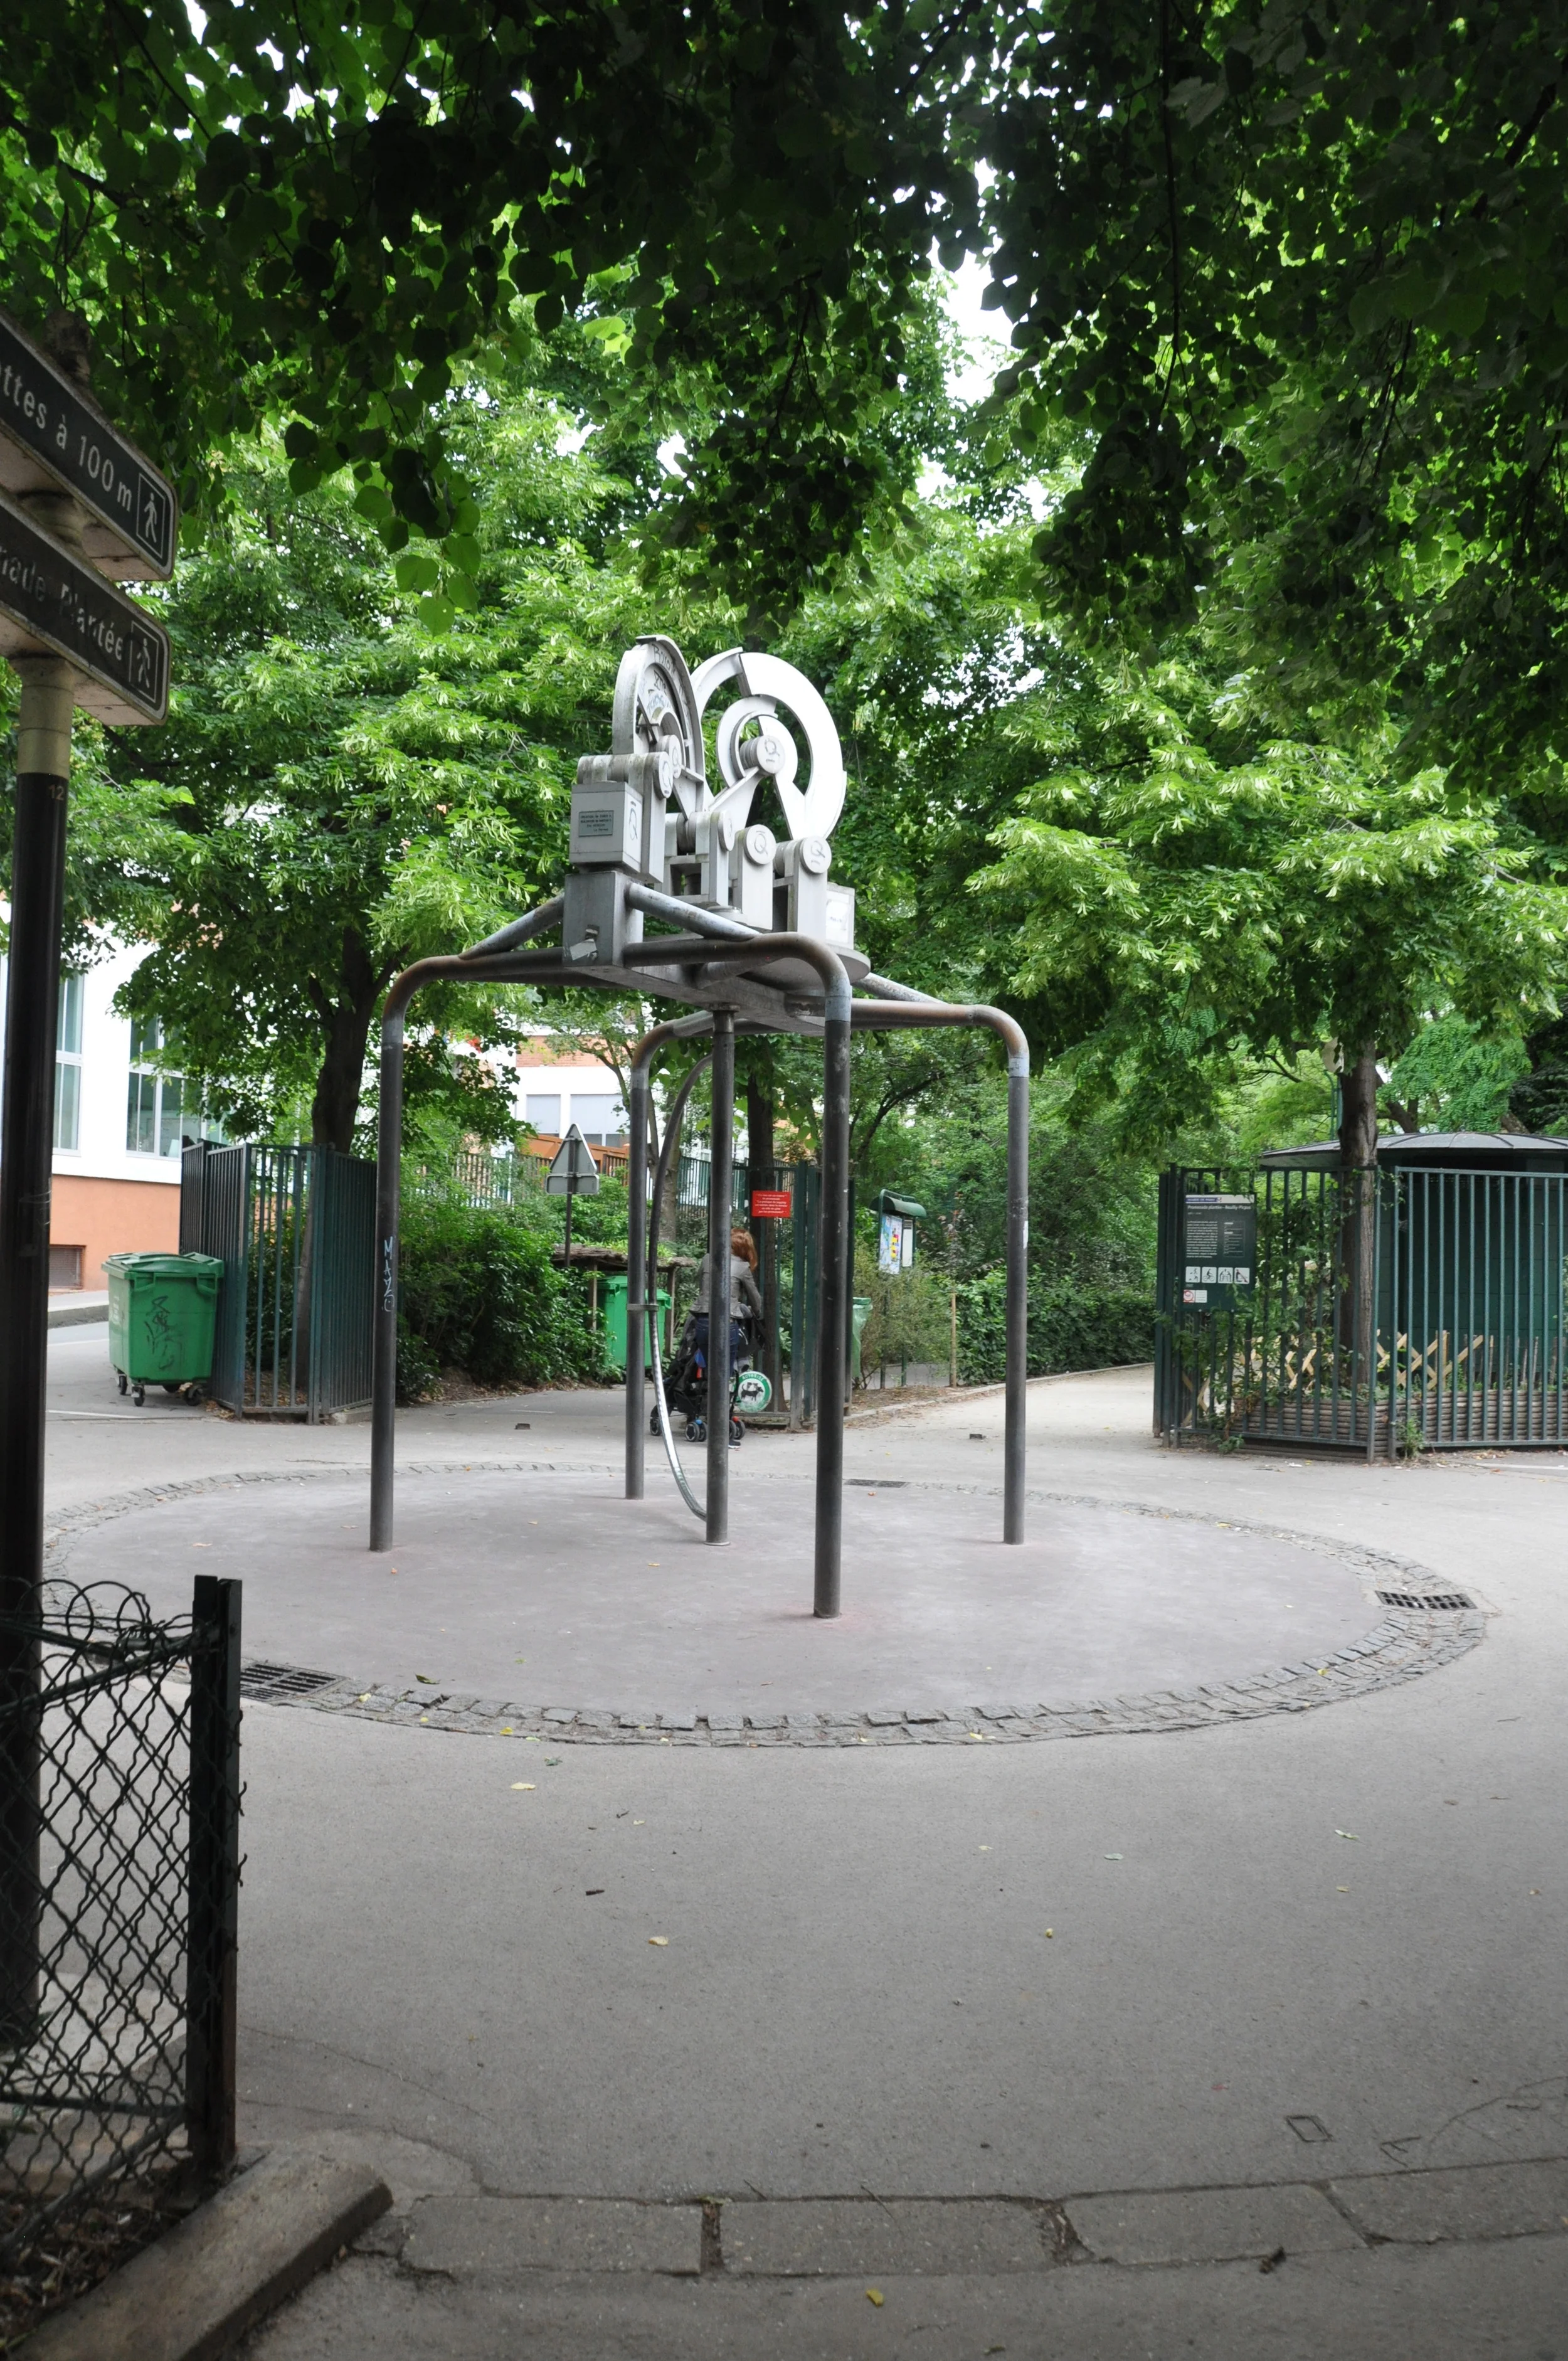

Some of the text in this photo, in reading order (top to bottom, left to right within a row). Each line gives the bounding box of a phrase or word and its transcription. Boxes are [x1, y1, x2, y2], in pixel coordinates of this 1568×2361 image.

[0, 361, 132, 512] ttes à 100 m
